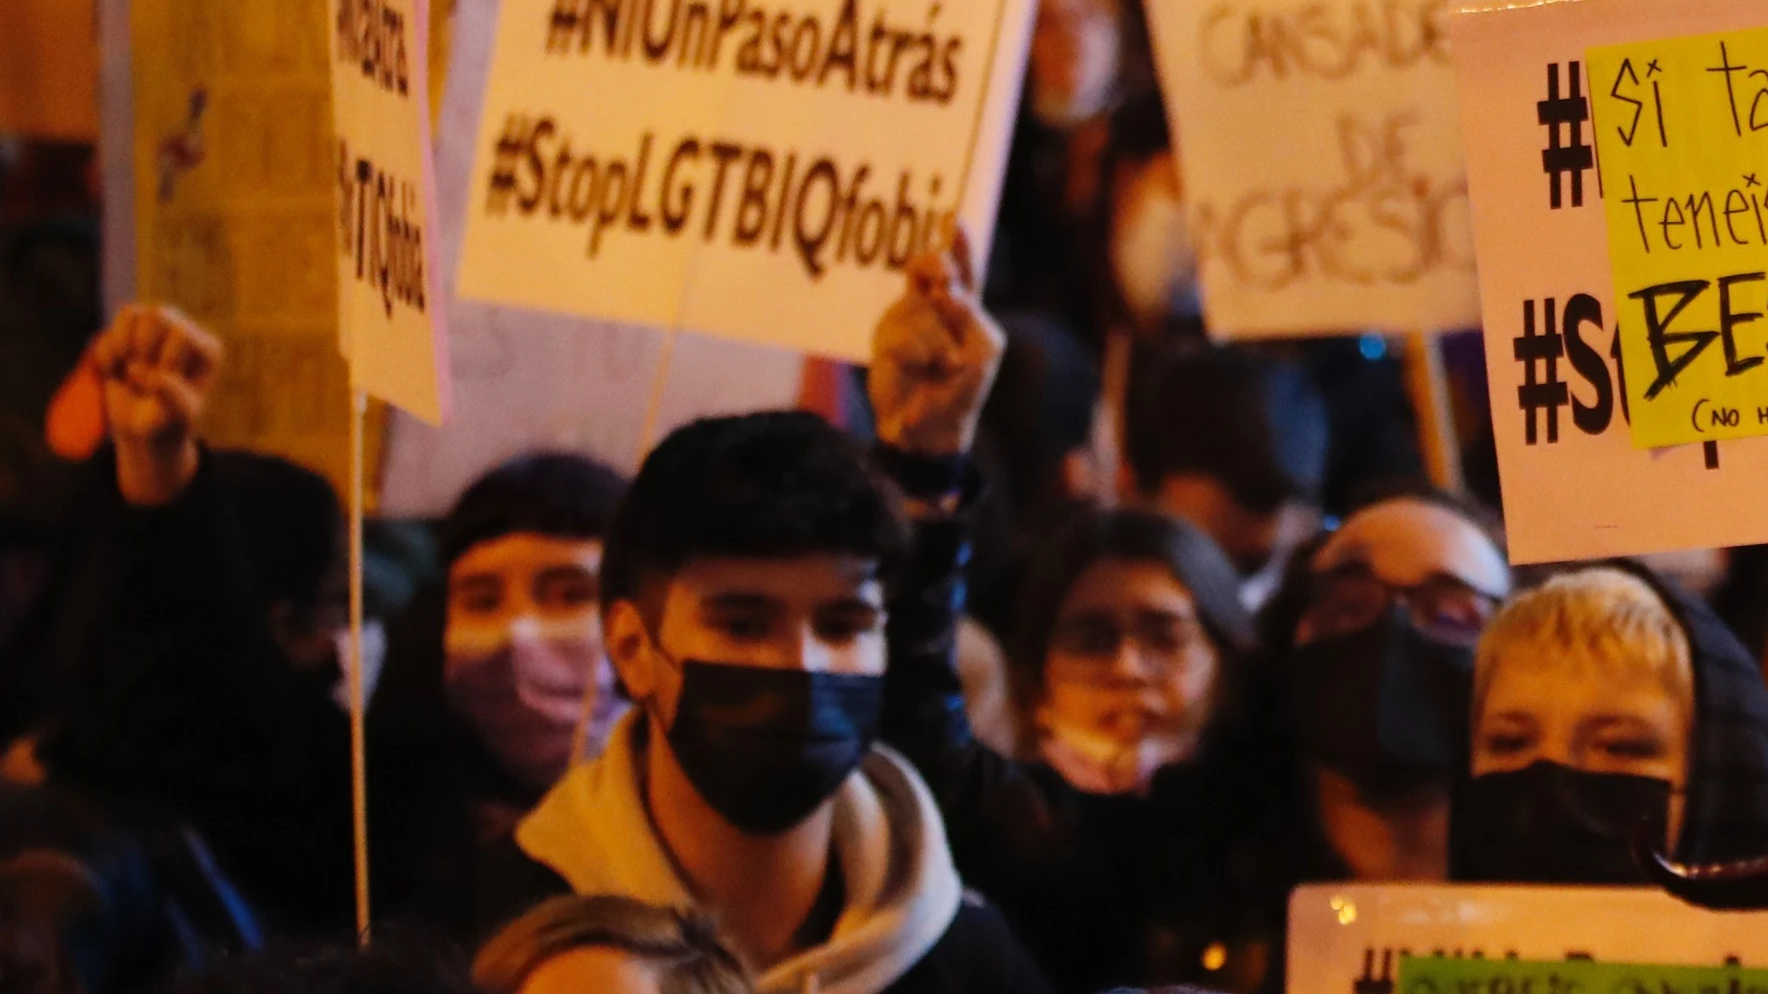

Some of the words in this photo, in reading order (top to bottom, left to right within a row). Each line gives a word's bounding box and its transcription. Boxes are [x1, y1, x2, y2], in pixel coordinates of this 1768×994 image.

[1334, 101, 1425, 186] DE
[484, 112, 944, 282] #StopLGTBIQfobi
[1691, 398, 1740, 433] (NO
